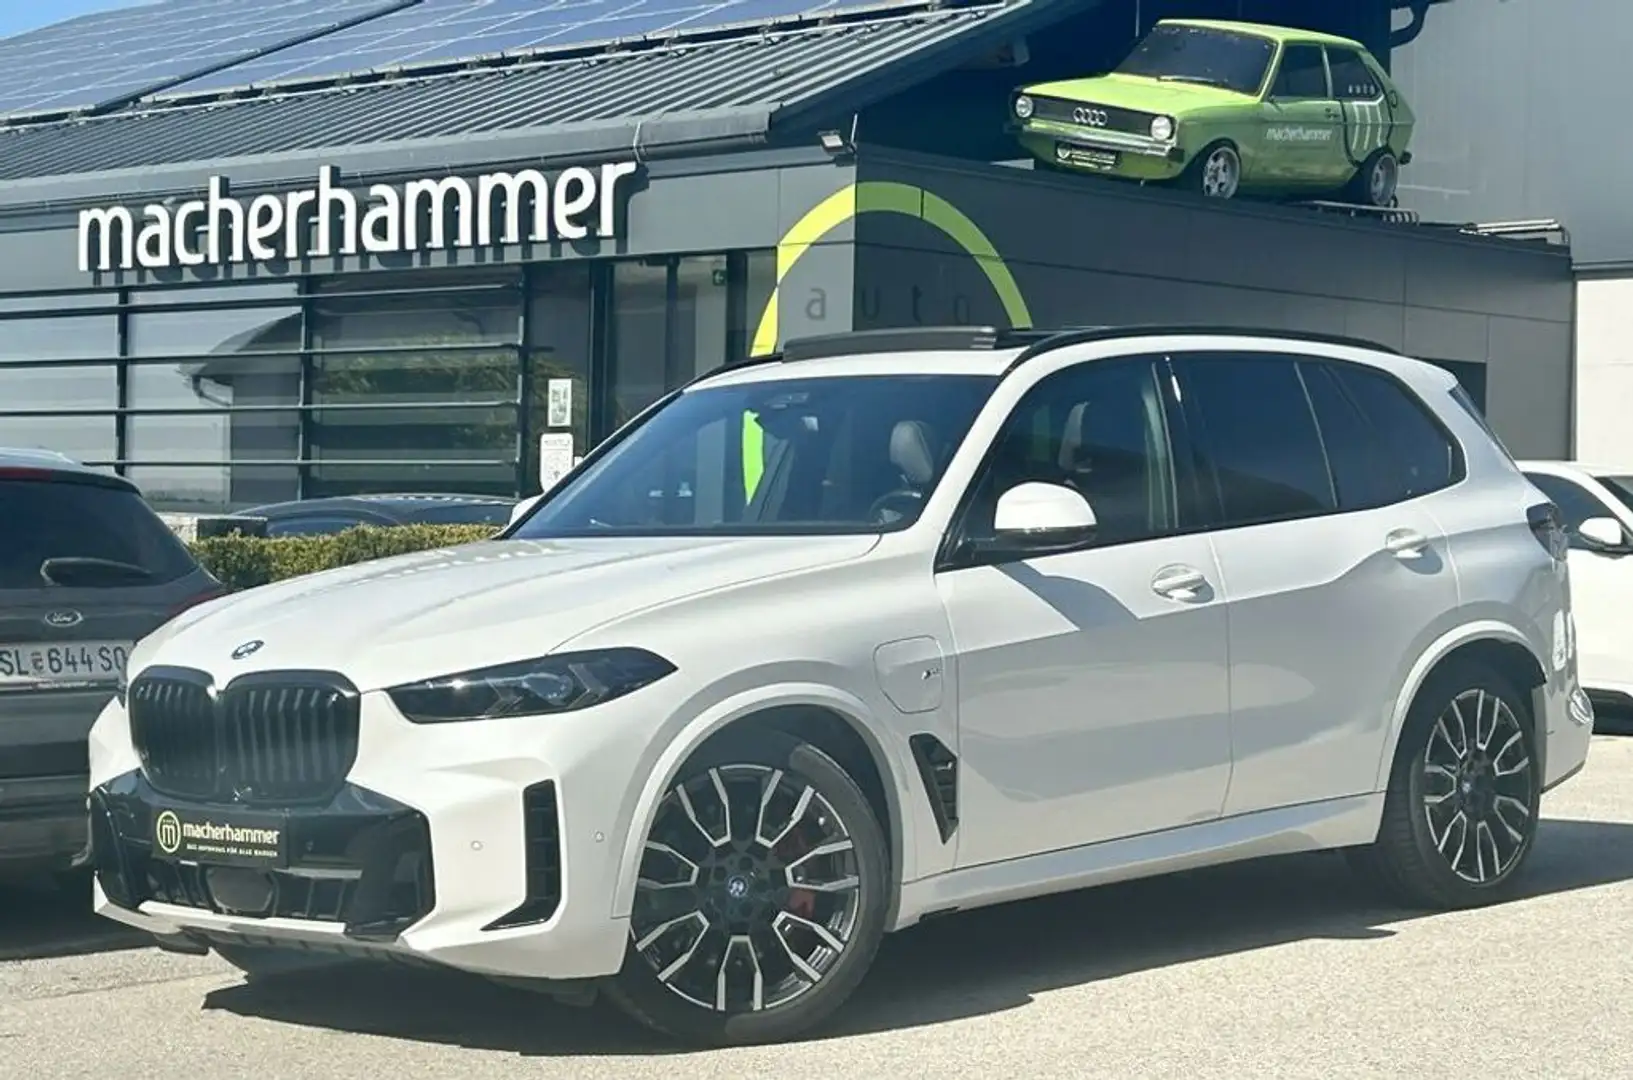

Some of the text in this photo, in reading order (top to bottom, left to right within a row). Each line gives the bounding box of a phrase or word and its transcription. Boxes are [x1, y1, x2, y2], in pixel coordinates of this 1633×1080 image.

[79, 161, 637, 271] macherhammer
[47, 647, 93, 674] 644
[183, 821, 280, 845] macherhammer
